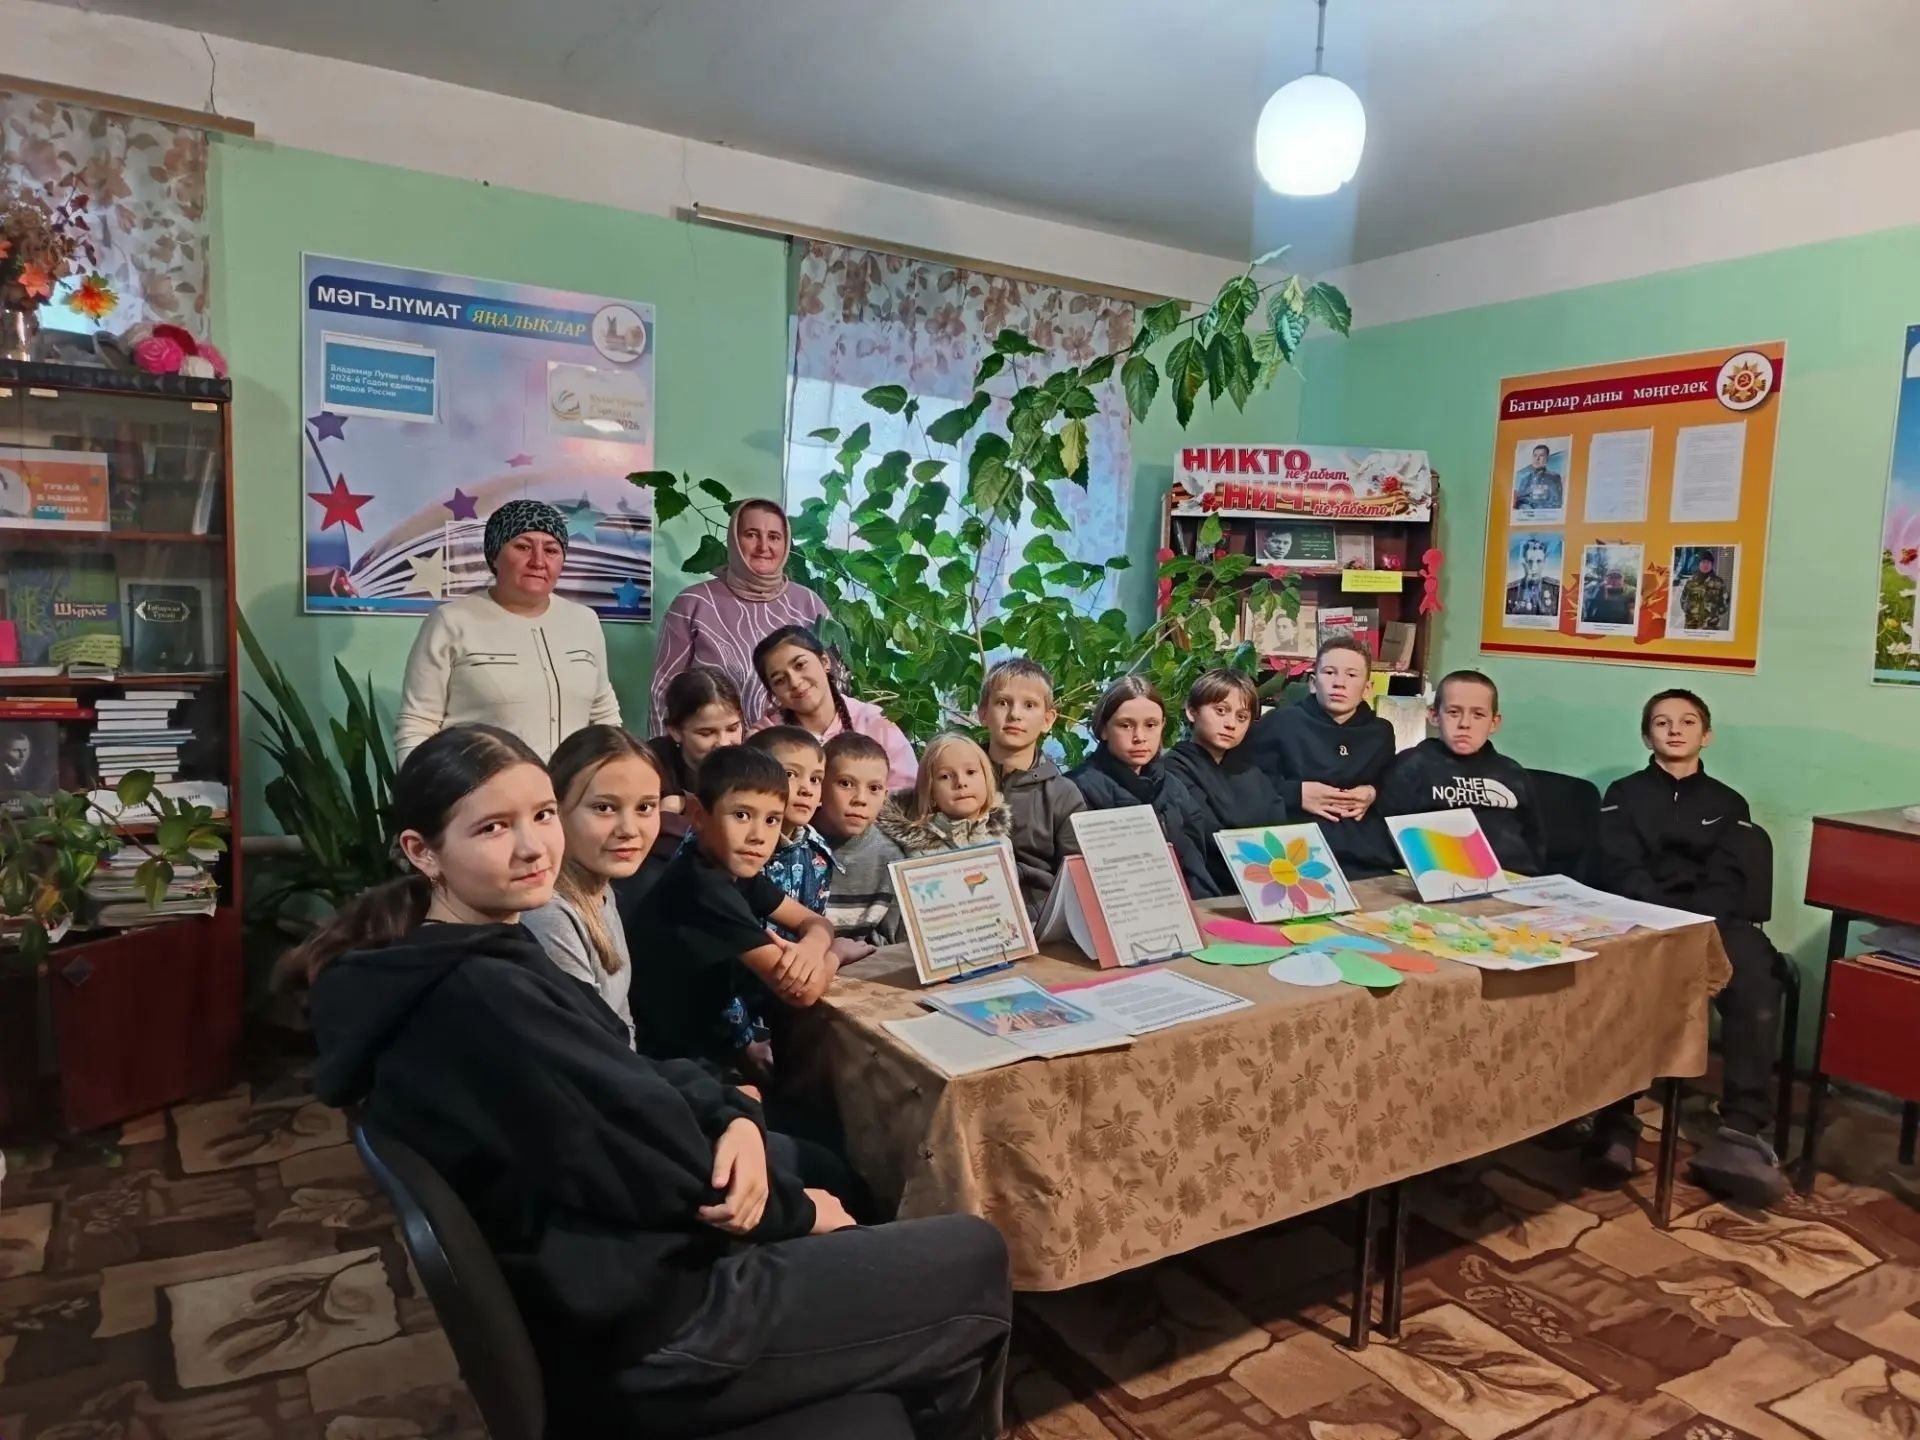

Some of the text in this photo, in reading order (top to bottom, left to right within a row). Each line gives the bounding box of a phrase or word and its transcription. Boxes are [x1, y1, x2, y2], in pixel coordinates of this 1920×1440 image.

[317, 285, 586, 338] МӘГЪЛҮМАТ ЯҢАЛЫКЛАР
[330, 364, 373, 377] Владимир
[374, 370, 399, 380] Путин
[330, 373, 427, 392] 2026-й Годом единства
[330, 384, 397, 397] народов России
[1508, 380, 1709, 413] Батырлар даны мәңгелек
[1182, 448, 1312, 474] НИКТО
[1285, 468, 1350, 482] не забыт,
[1223, 481, 1355, 511] НИЧТО
[1312, 504, 1330, 515] не
[1331, 503, 1389, 517] забыто
[1452, 776, 1483, 790] THE
[1432, 786, 1488, 800] NORTH
